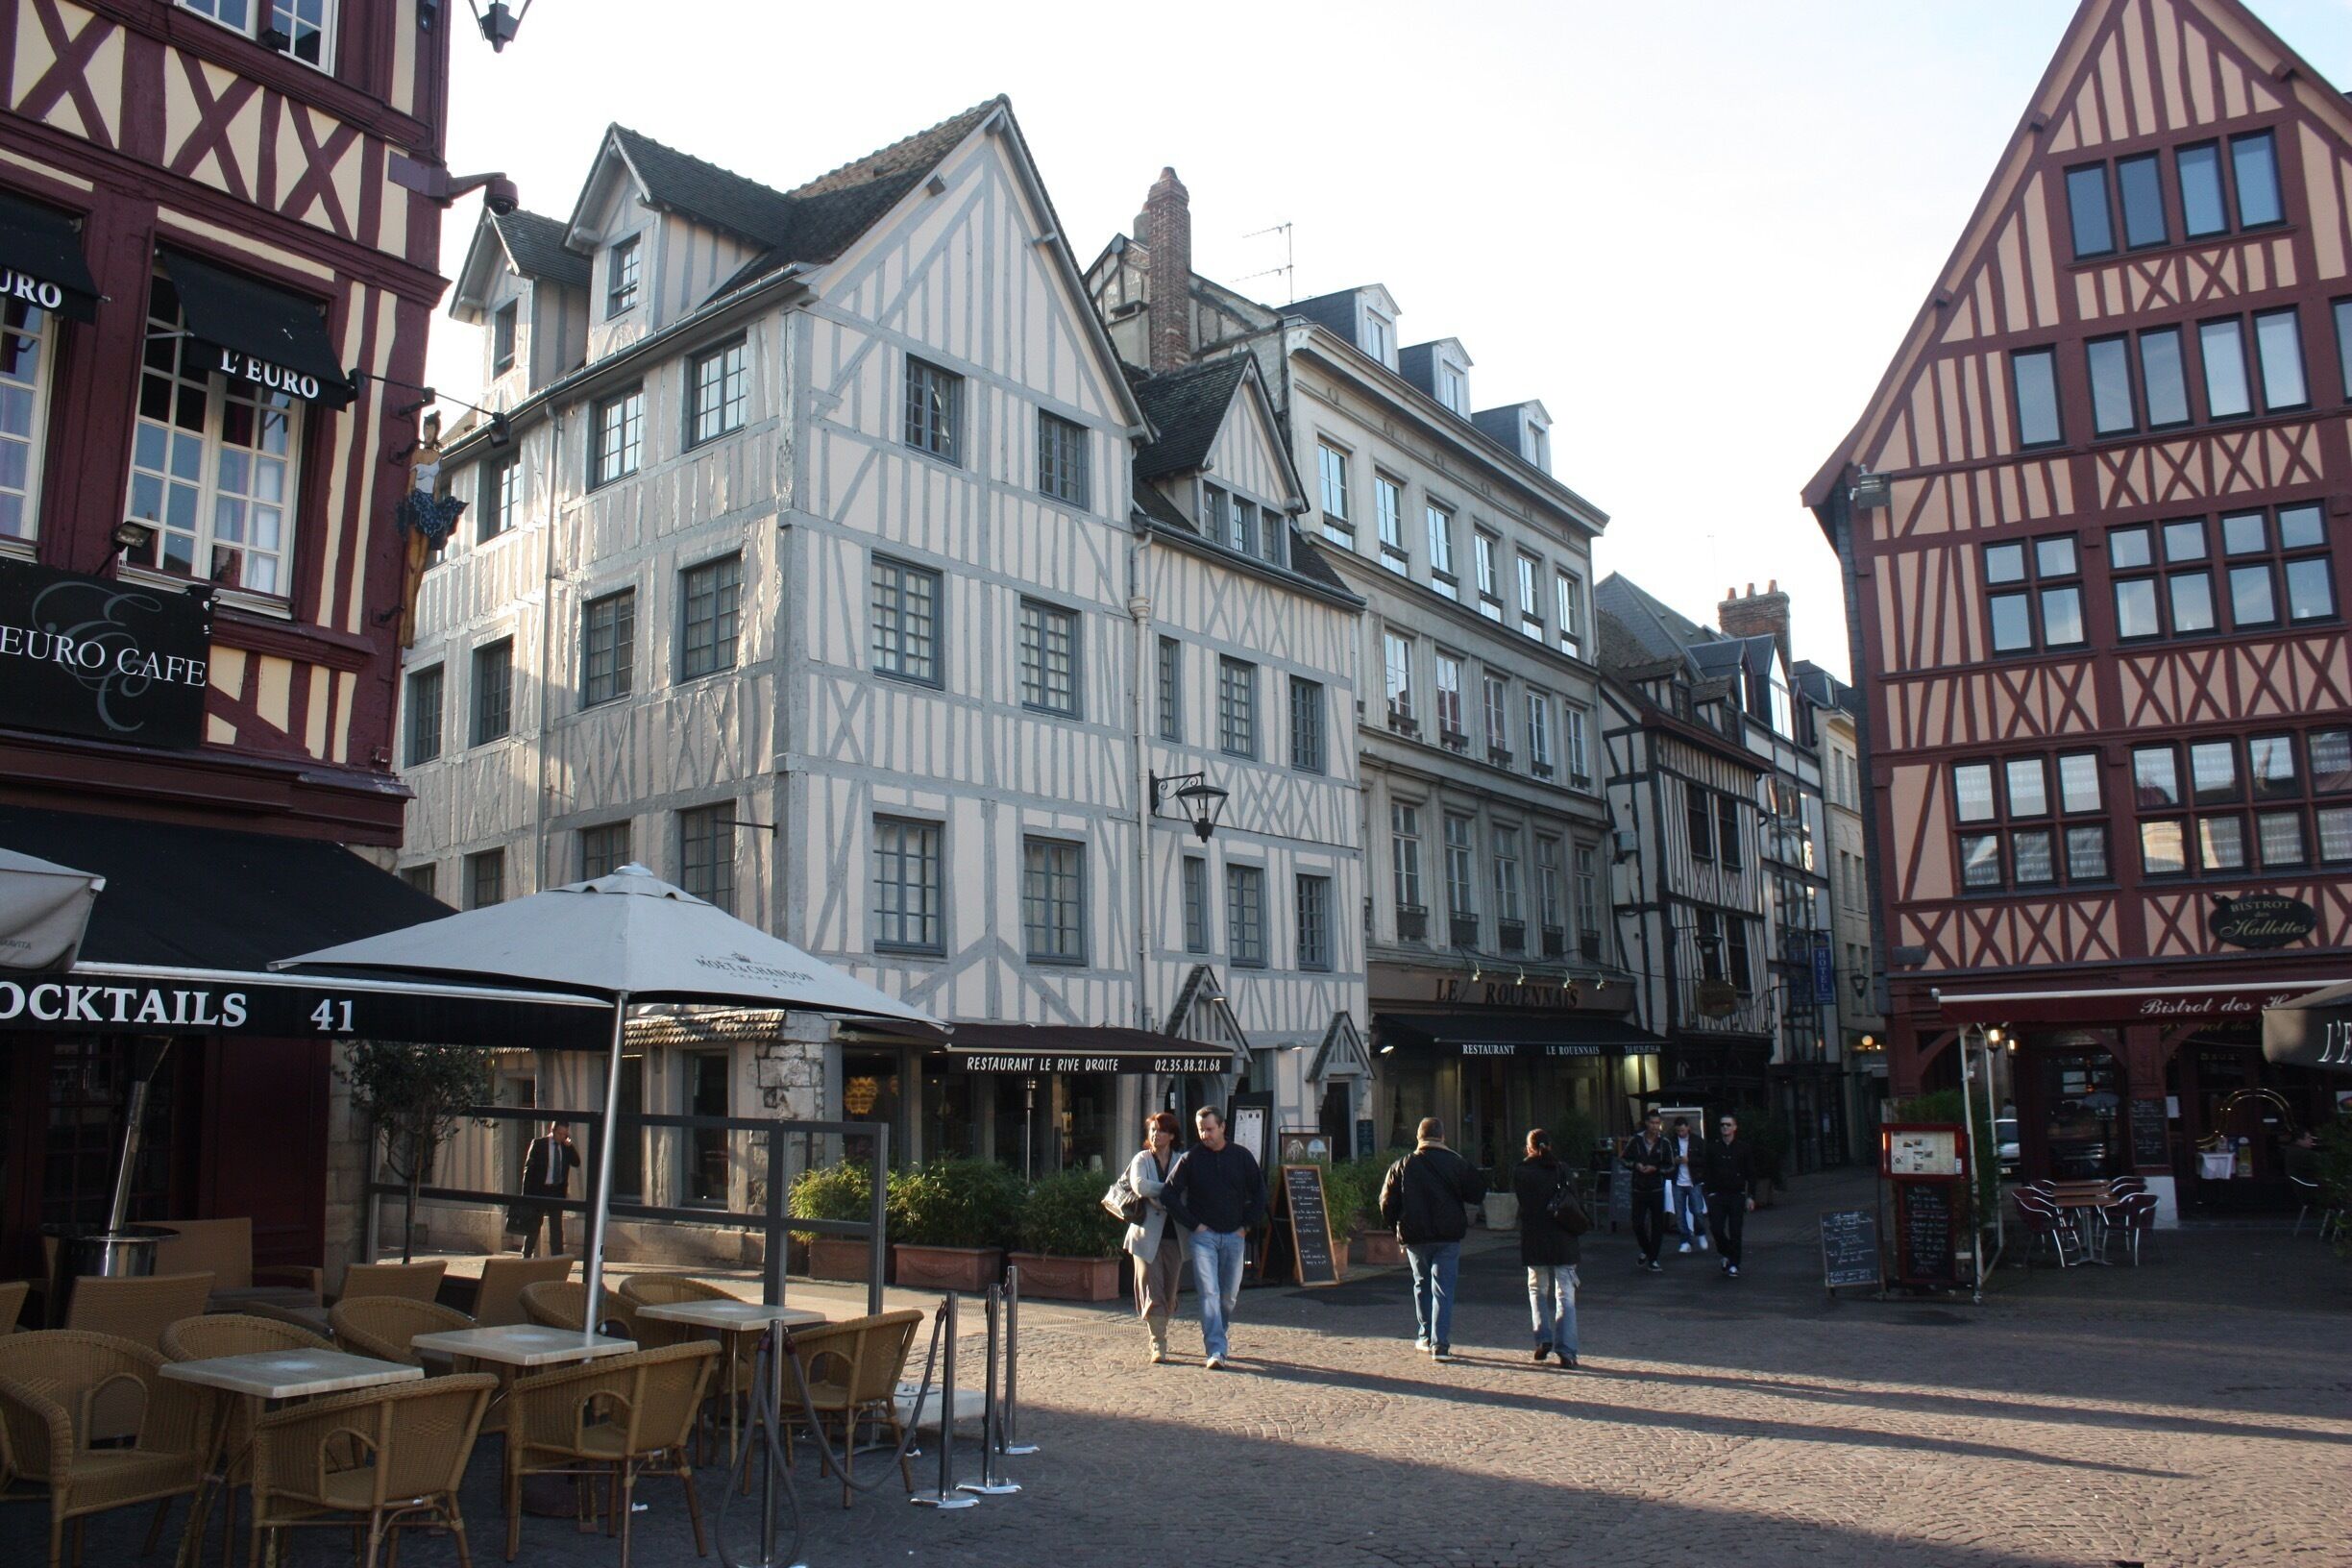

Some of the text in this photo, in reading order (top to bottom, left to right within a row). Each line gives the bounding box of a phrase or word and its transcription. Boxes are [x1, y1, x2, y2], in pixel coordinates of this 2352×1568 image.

[246, 355, 319, 399] EURO
[0, 625, 207, 687] EURO CAFE
[2230, 900, 2291, 913] BISTROT
[2220, 919, 2307, 938] Hallettes
[746, 965, 816, 982] CHANDON
[1436, 978, 1579, 1008] LE ROUENNAIS
[310, 998, 354, 1032] 41
[2140, 998, 2214, 1015] Bistrot
[2220, 996, 2252, 1012] des
[1462, 1044, 1600, 1055] RESTAURANT LE ROUENNAIS
[967, 1057, 1118, 1071] RESTAURANT LE RIVE DROITE
[1155, 1058, 1221, 1072] 02.35.88.21.68
